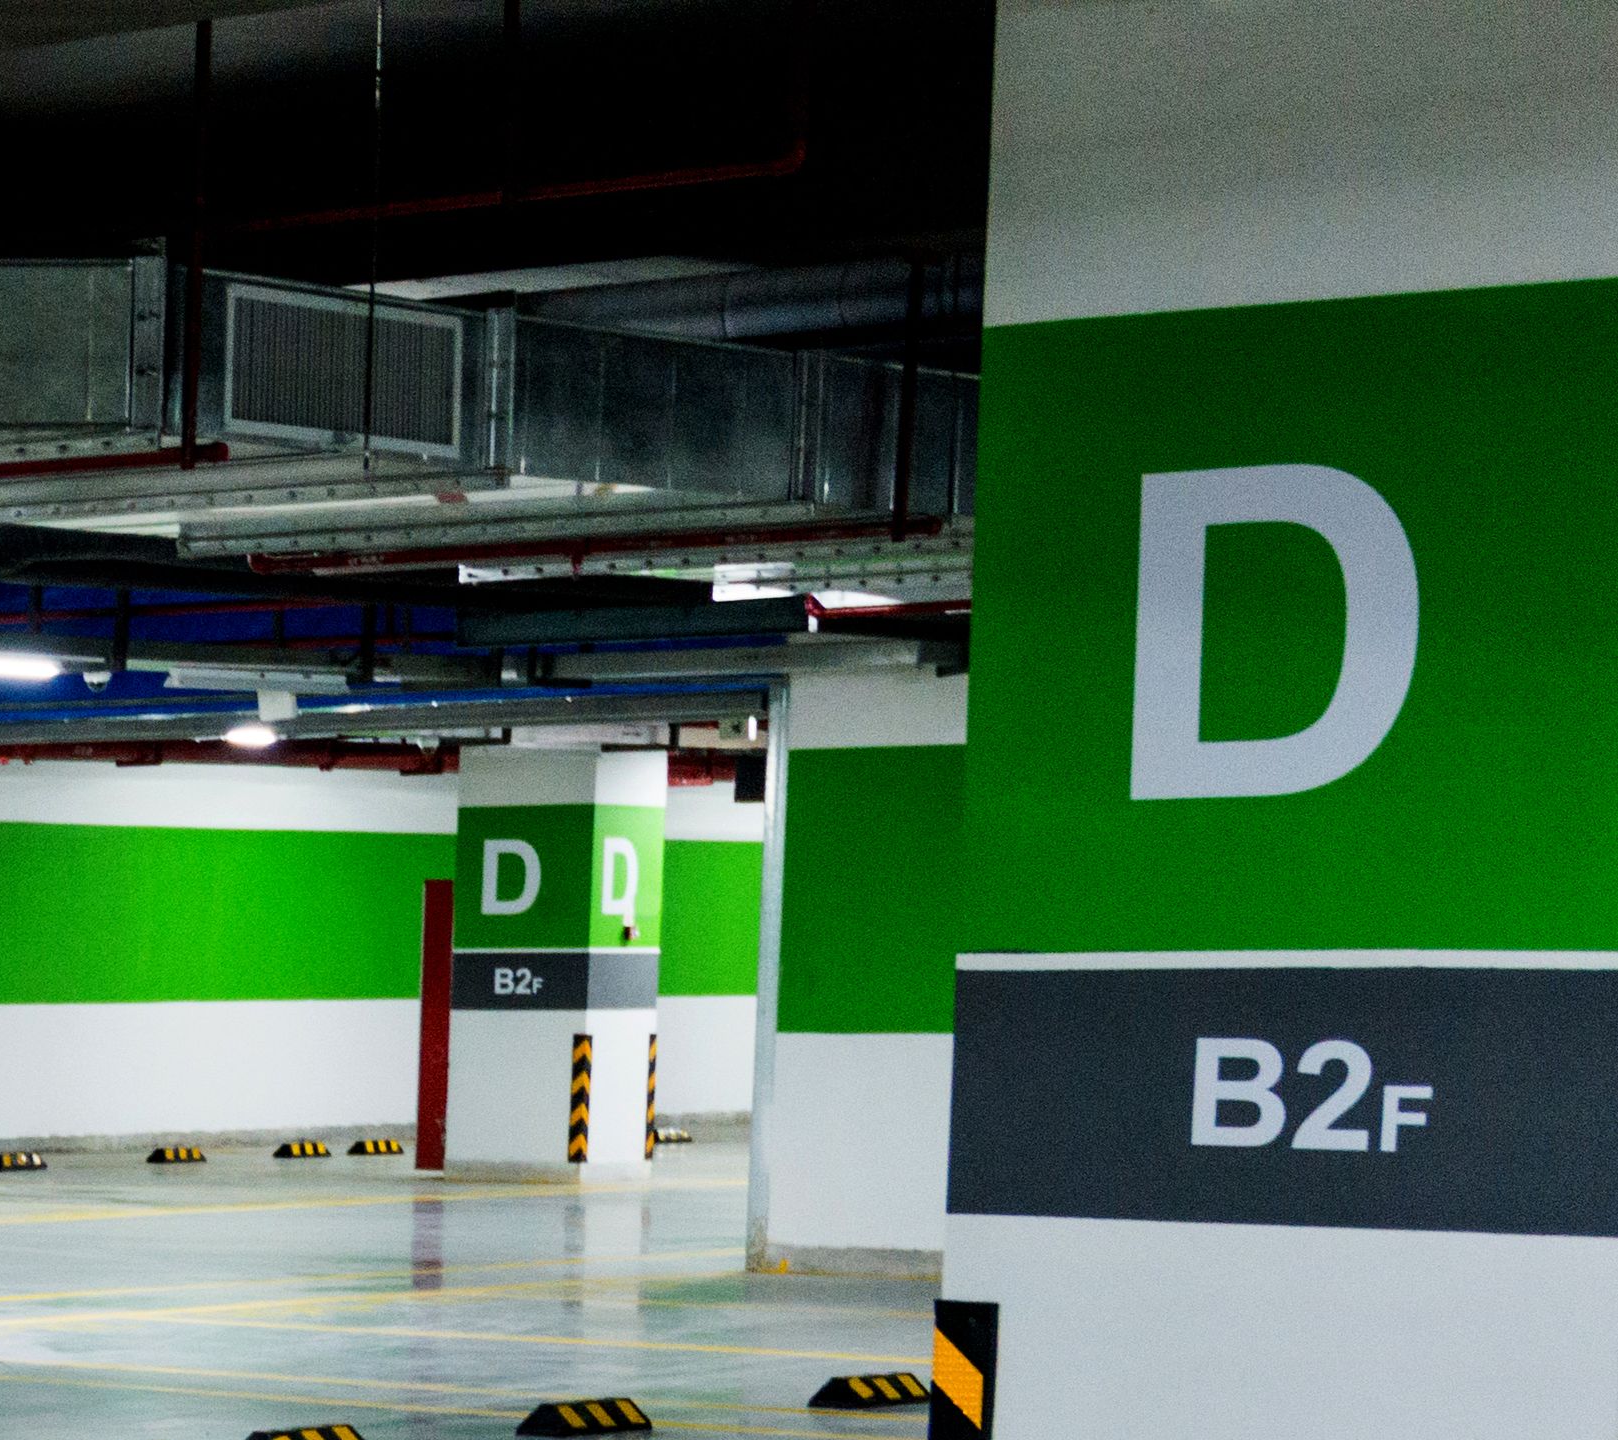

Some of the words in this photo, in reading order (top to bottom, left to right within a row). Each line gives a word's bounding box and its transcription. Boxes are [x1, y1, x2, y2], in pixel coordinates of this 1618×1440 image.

[1132, 464, 1419, 799] D
[481, 839, 541, 915] D
[601, 837, 639, 916] D
[493, 967, 544, 996] B2F
[1190, 1037, 1436, 1154] B2F
